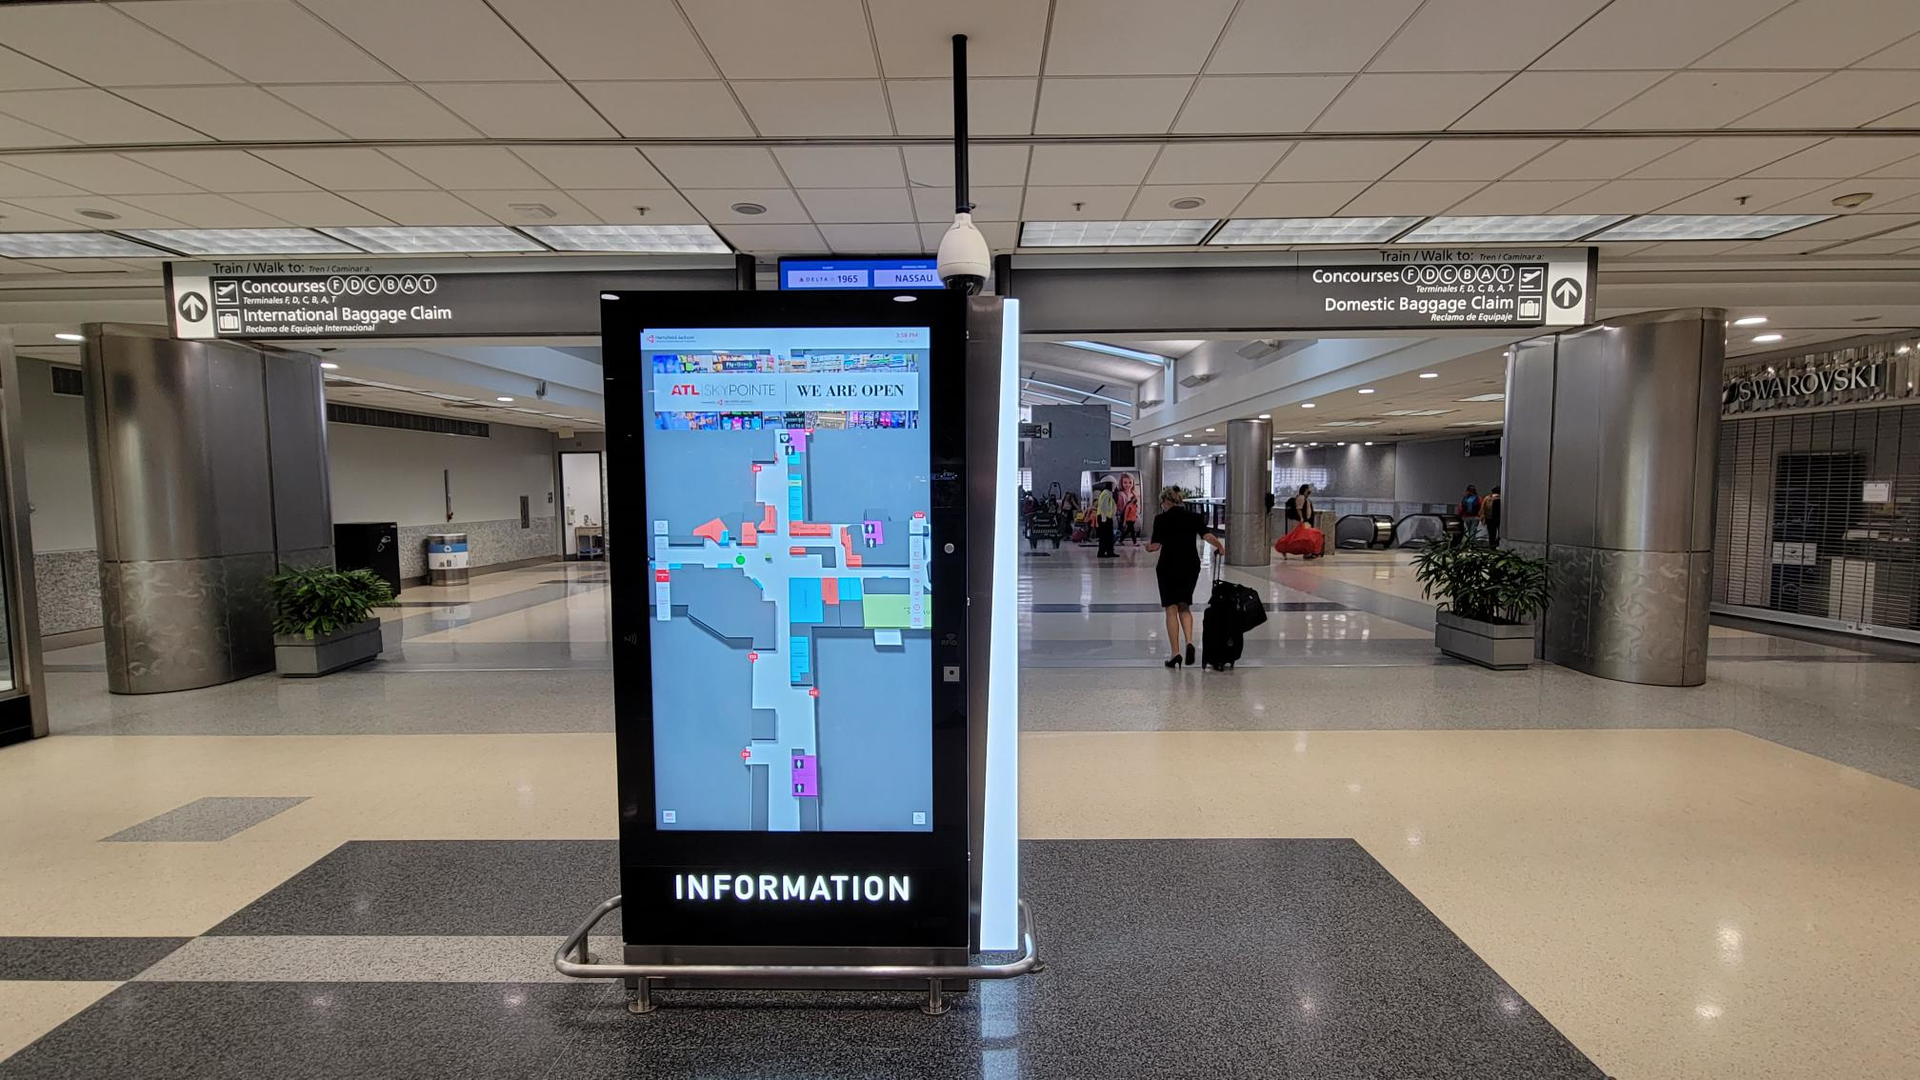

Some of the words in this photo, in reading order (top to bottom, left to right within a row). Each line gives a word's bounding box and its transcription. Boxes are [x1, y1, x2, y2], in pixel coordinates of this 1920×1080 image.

[1380, 250, 1410, 262] Train
[1421, 250, 1453, 261] Walk
[1456, 251, 1474, 261] to:
[213, 262, 243, 274] Train
[253, 262, 284, 273] Walk
[288, 262, 305, 273] to:
[309, 265, 325, 273] Tren
[837, 274, 859, 283] 1965
[895, 274, 934, 283] NASSAU
[1312, 269, 1400, 283] Concourses
[241, 279, 326, 294] Concourses
[1416, 285, 1458, 293] Terminales
[1508, 284, 1514, 292] T
[243, 296, 284, 304] Terminales
[331, 295, 337, 303] T
[1325, 297, 1395, 311] Domestic
[1399, 297, 1467, 314] Baggage
[1471, 295, 1514, 310] Claim
[243, 307, 338, 322] International
[342, 307, 407, 323] Baggage
[410, 305, 452, 320] Claim
[1430, 313, 1464, 321] Reclamo
[1478, 312, 1513, 322] Equipaje
[245, 325, 278, 333] Reclamo
[279, 324, 289, 332] de
[290, 324, 324, 334] Equipaje
[325, 323, 375, 332] Internacional
[1738, 364, 1878, 402] SWAROVSKI
[671, 384, 700, 395] ATL
[703, 383, 776, 396] SKYPOINTE
[797, 384, 822, 396] WE
[826, 384, 857, 396] ARE
[861, 384, 904, 397] OPEN
[674, 874, 910, 902] INFORMATION
